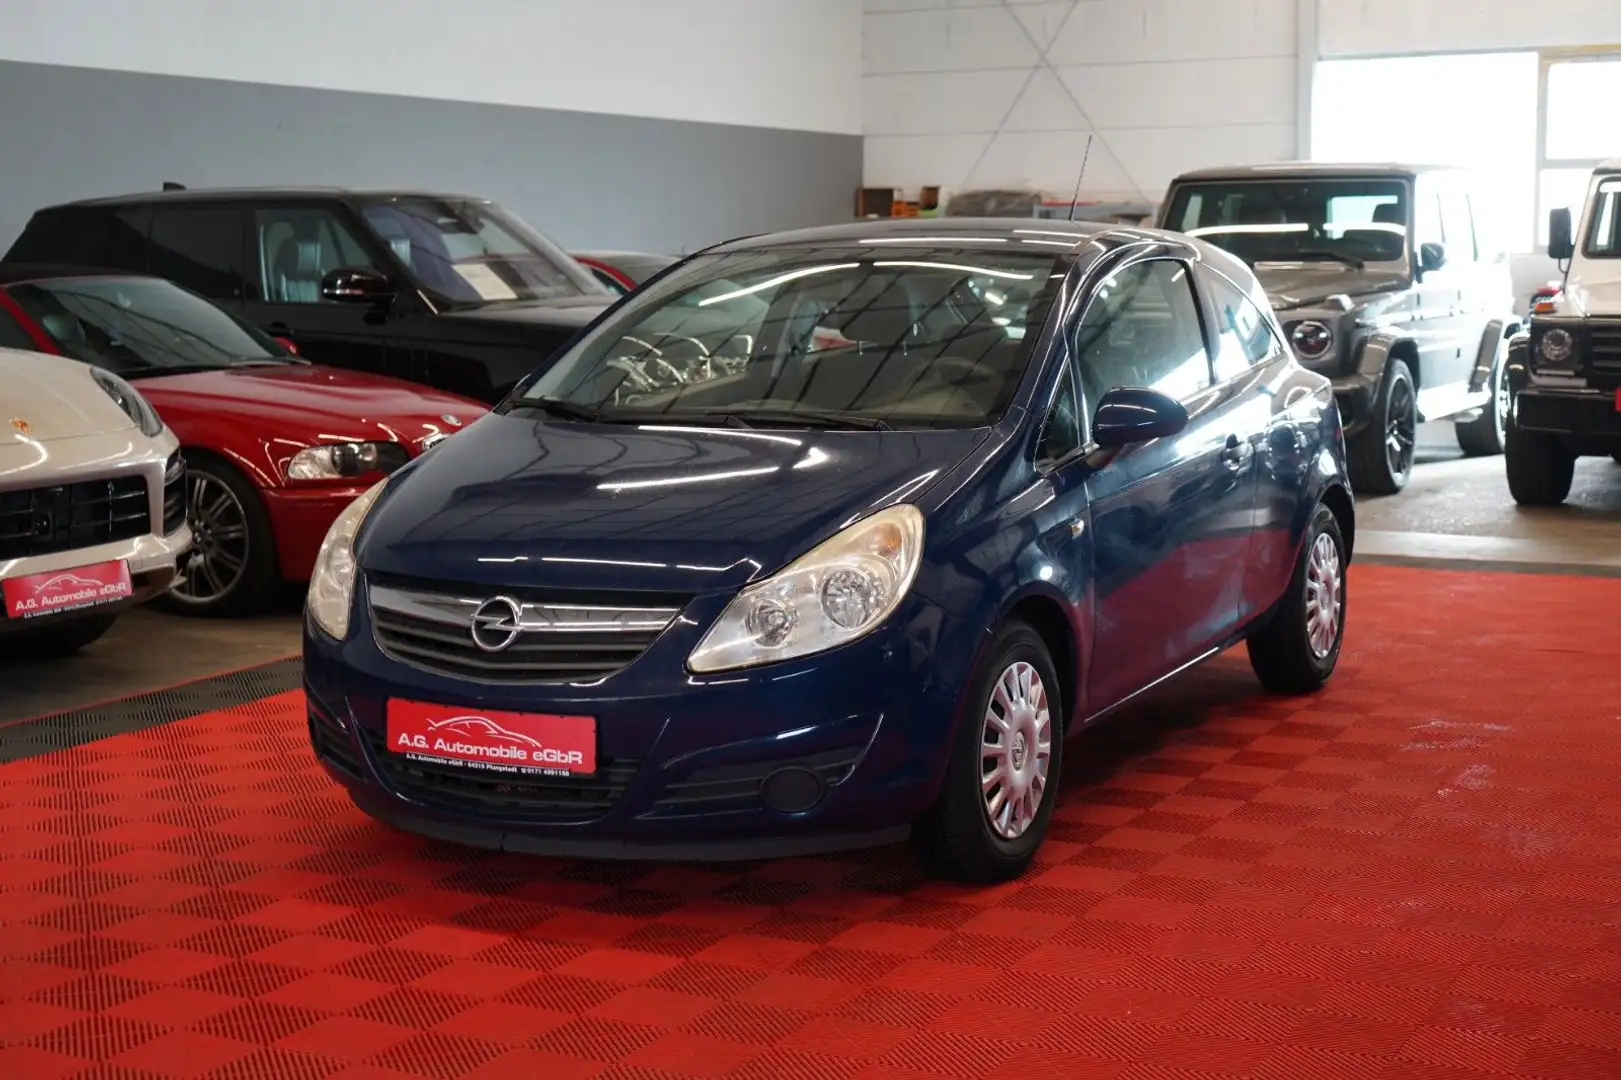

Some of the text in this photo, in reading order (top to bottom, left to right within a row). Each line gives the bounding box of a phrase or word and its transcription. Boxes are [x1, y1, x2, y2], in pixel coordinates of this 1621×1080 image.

[15, 598, 39, 611] A.G.
[42, 588, 97, 606] Automobile
[100, 583, 126, 595] eGbR
[398, 733, 583, 764] A.G. Automobile eGbR
[418, 755, 447, 764] Automobile
